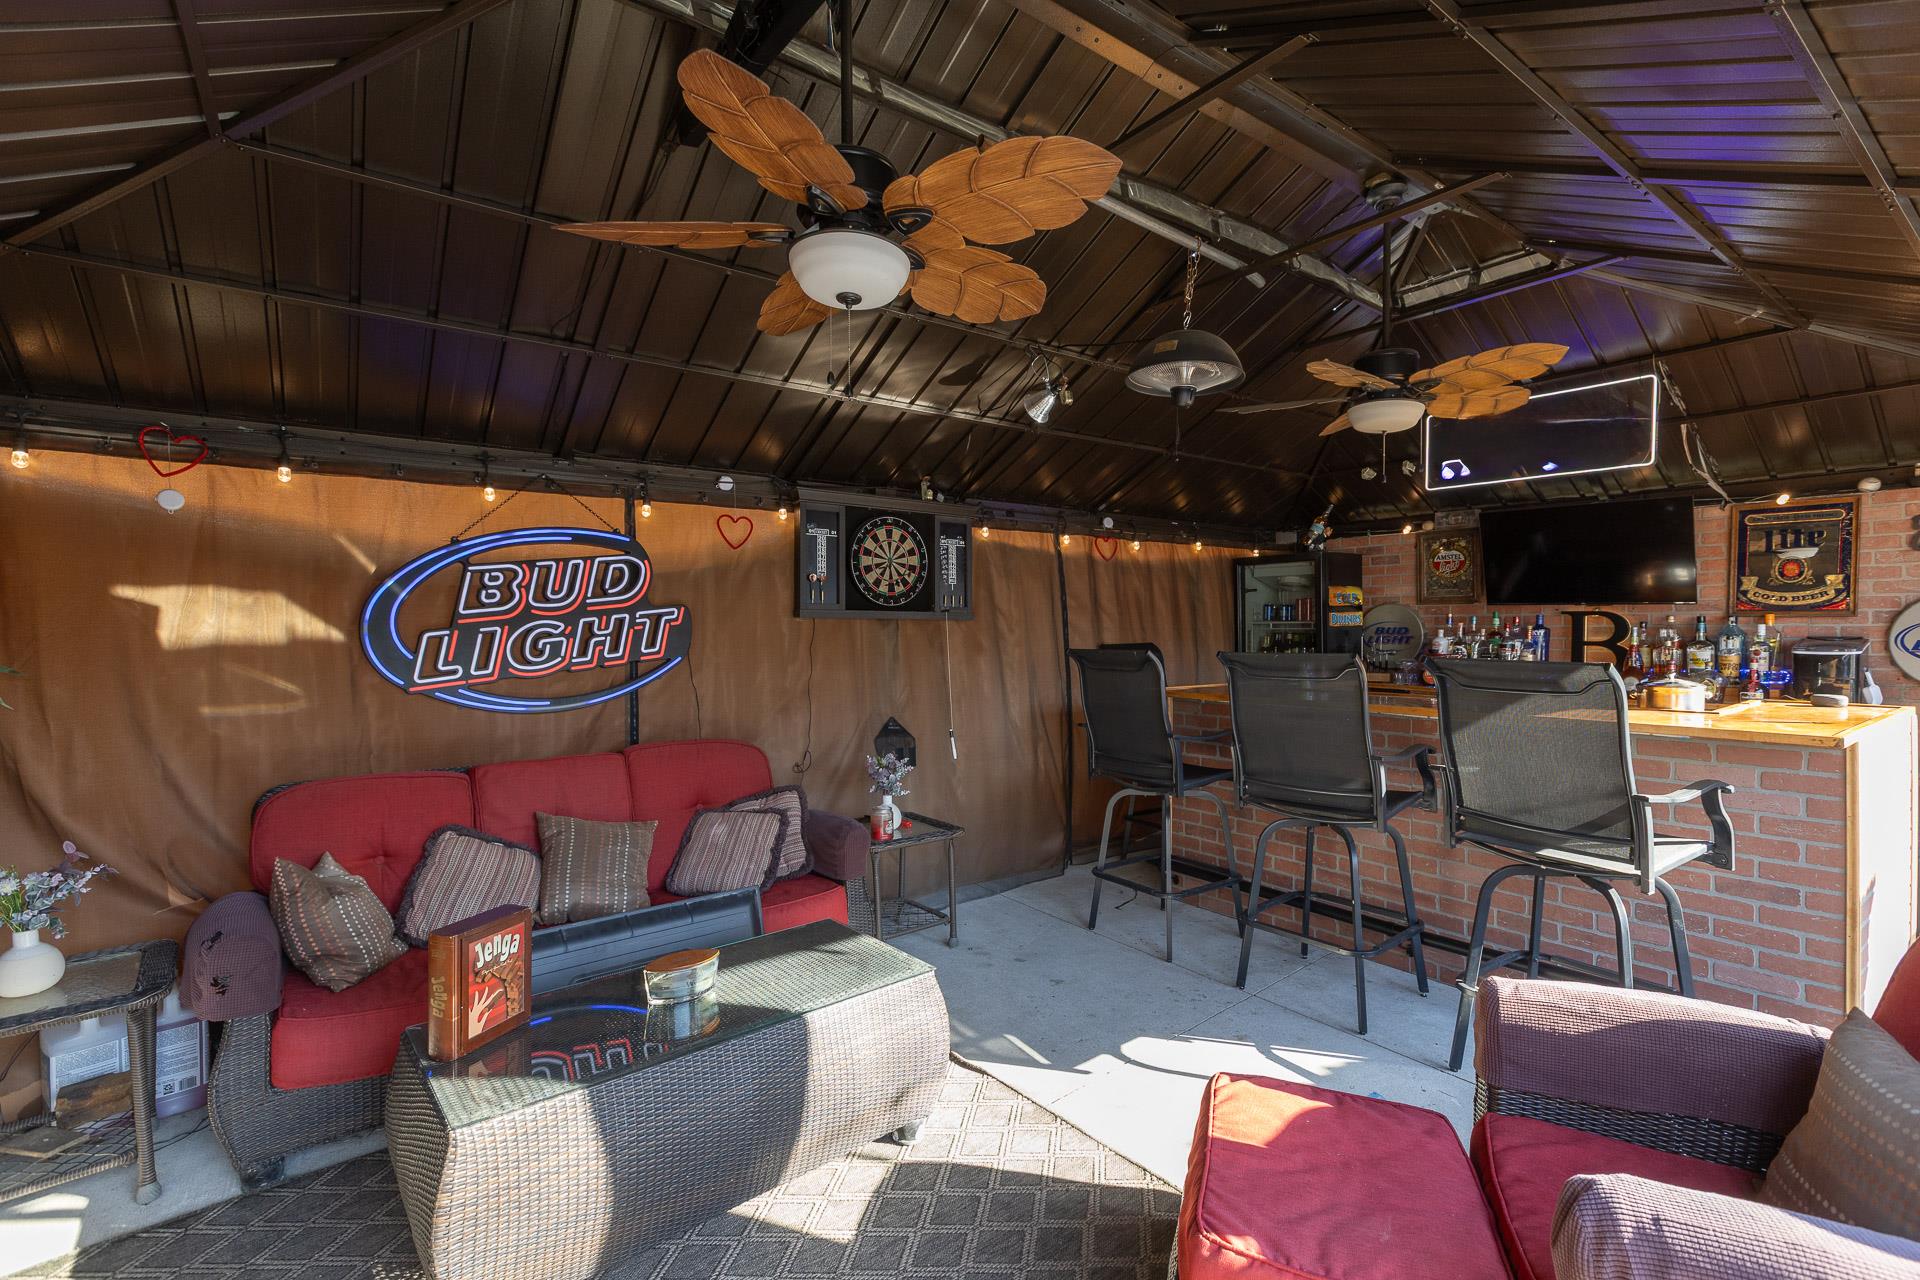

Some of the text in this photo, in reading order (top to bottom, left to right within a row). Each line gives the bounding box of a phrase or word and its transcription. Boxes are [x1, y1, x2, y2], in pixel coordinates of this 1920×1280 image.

[1764, 528, 1827, 553] Lite
[1436, 553, 1463, 561] AMSTEL
[457, 555, 651, 624] BUD
[1752, 590, 1830, 602] COLD BEER
[1331, 612, 1361, 625] DRINKS
[1375, 626, 1409, 635] BUD
[408, 605, 685, 692] LIGHT
[1367, 635, 1413, 645] LIGHT
[1561, 610, 1631, 672] B
[474, 933, 520, 969] Jenga
[430, 975, 448, 1018] Jenga
